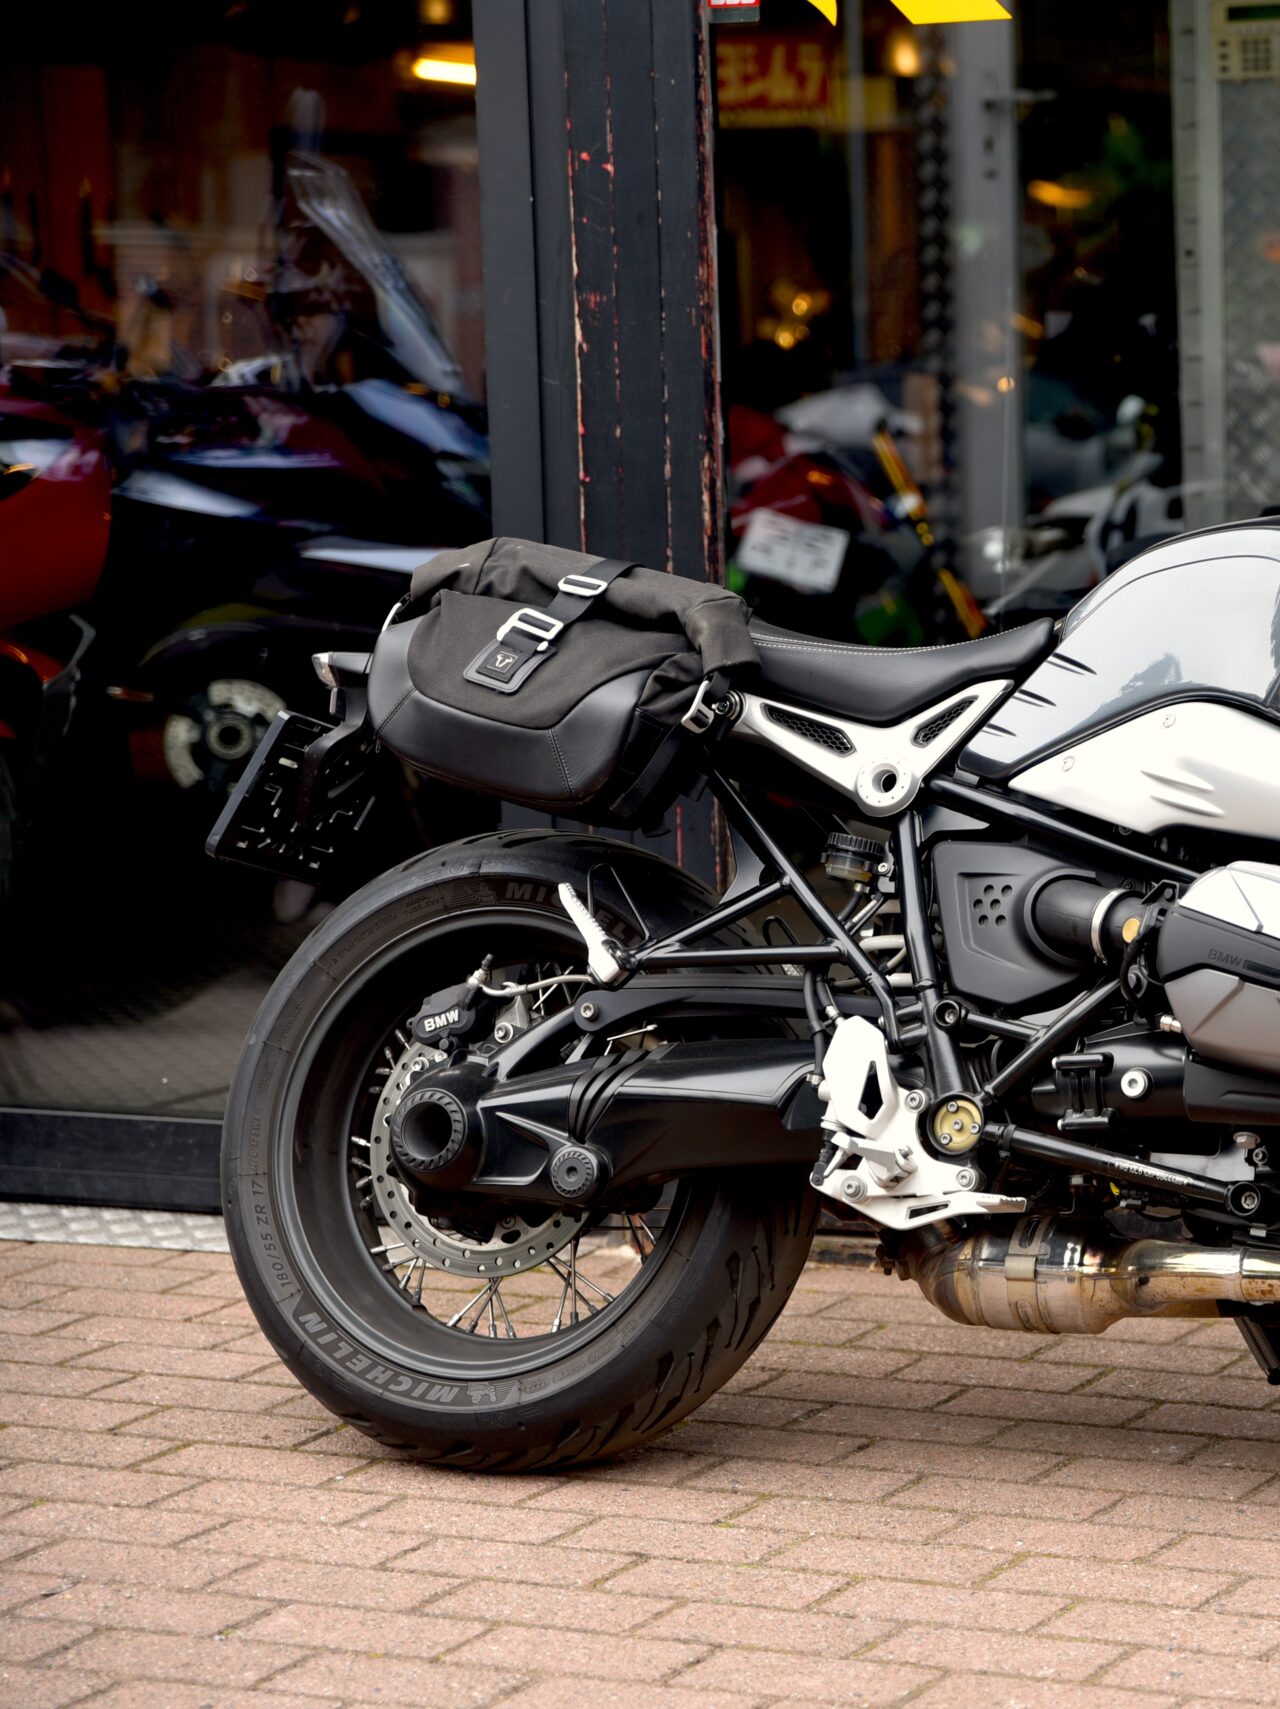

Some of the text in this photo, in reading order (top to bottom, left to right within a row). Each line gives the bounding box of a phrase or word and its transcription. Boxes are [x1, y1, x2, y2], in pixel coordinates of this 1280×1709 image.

[1207, 948, 1242, 969] BMW
[423, 1009, 459, 1032] BMW
[251, 1179, 265, 1197] 17
[254, 1204, 270, 1226] ZR
[260, 1232, 292, 1288] 180/55
[298, 1311, 460, 1403] MICHELIN
